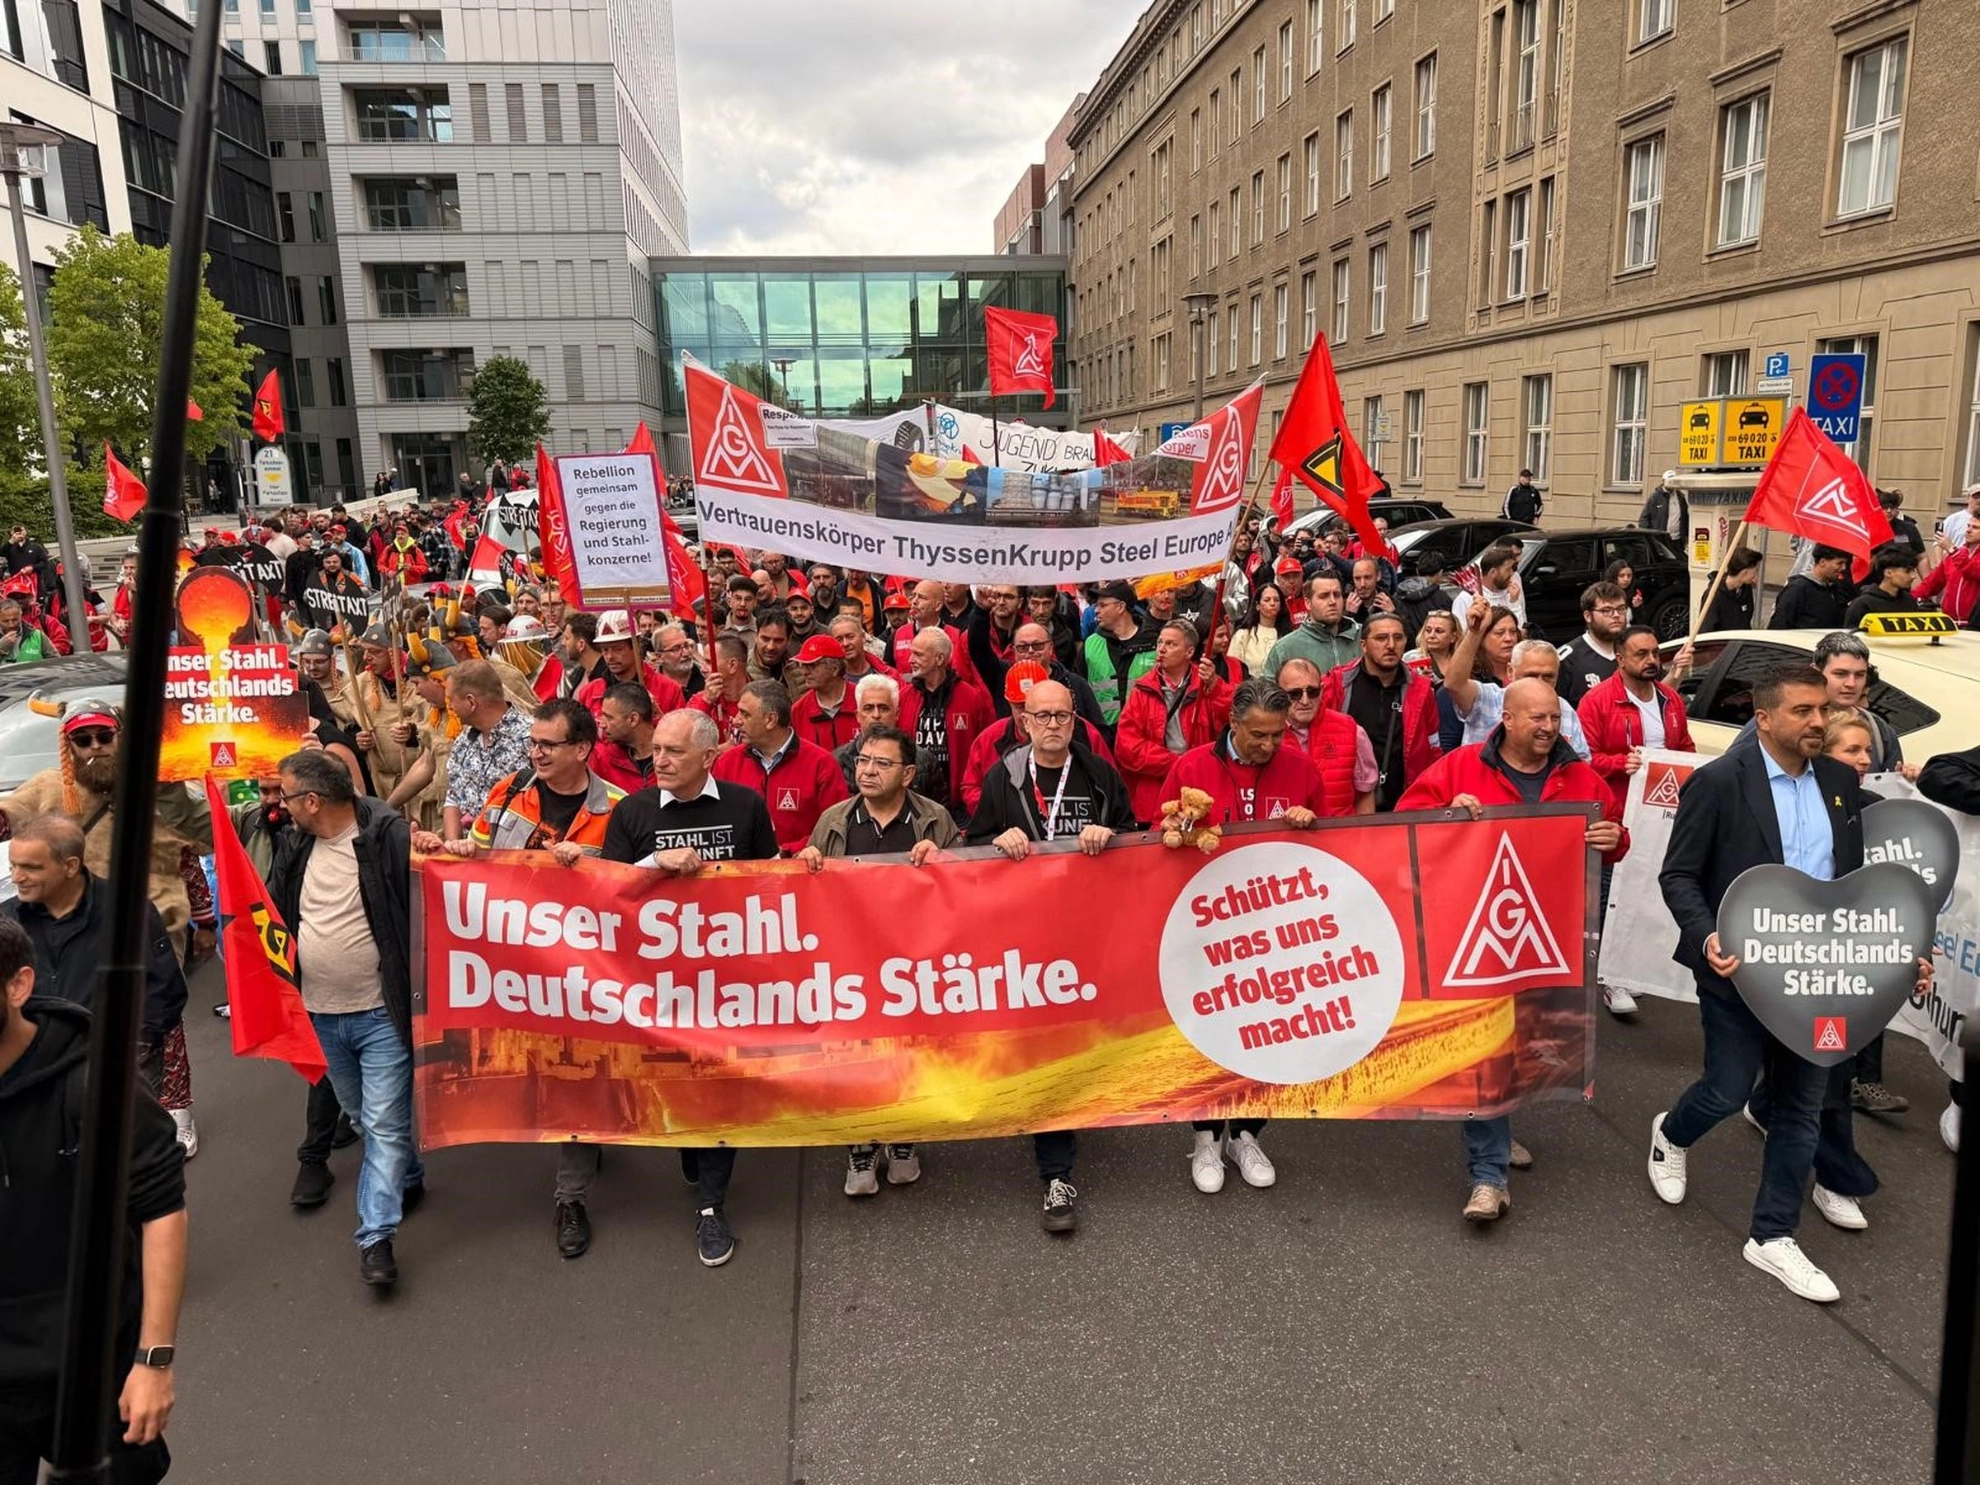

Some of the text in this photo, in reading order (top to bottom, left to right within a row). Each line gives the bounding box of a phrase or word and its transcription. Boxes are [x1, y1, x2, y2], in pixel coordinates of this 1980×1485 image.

[979, 427, 1057, 461] JUGEND
[1064, 444, 1096, 461] BRAU
[1689, 446, 1708, 460] TAXI
[1738, 446, 1766, 459] TAXI
[573, 466, 635, 480] Rebellion
[576, 482, 638, 498] gemeinsam
[584, 500, 637, 515] gegen die
[579, 518, 648, 532] Regierung
[698, 500, 886, 556] Vertrauenskörper
[892, 535, 1092, 572] ThyssenKrupp
[1099, 538, 1158, 564] Steel
[1164, 530, 1225, 558] Europe
[583, 534, 650, 549] und Stahl-
[587, 552, 653, 566] konzerne!
[1887, 618, 1948, 632] TAXI
[168, 648, 284, 671] nser Stahl.
[165, 673, 294, 699] eutschlands
[181, 702, 260, 725] Stärke.
[655, 830, 733, 849] STAHL IST
[1864, 837, 1923, 865] tahl.
[1191, 866, 1330, 928] Schützt,
[442, 880, 820, 960] Unser Stahl.
[1753, 908, 1905, 933] Unser Stahl.
[1203, 913, 1340, 968] was uns
[1743, 939, 1914, 964] Deutschlands
[448, 948, 1098, 1029] Deutschlands Stärke.
[1192, 944, 1380, 1017] erfolgreich
[1783, 970, 1875, 996] Stärke.
[1238, 995, 1357, 1051] macht!
